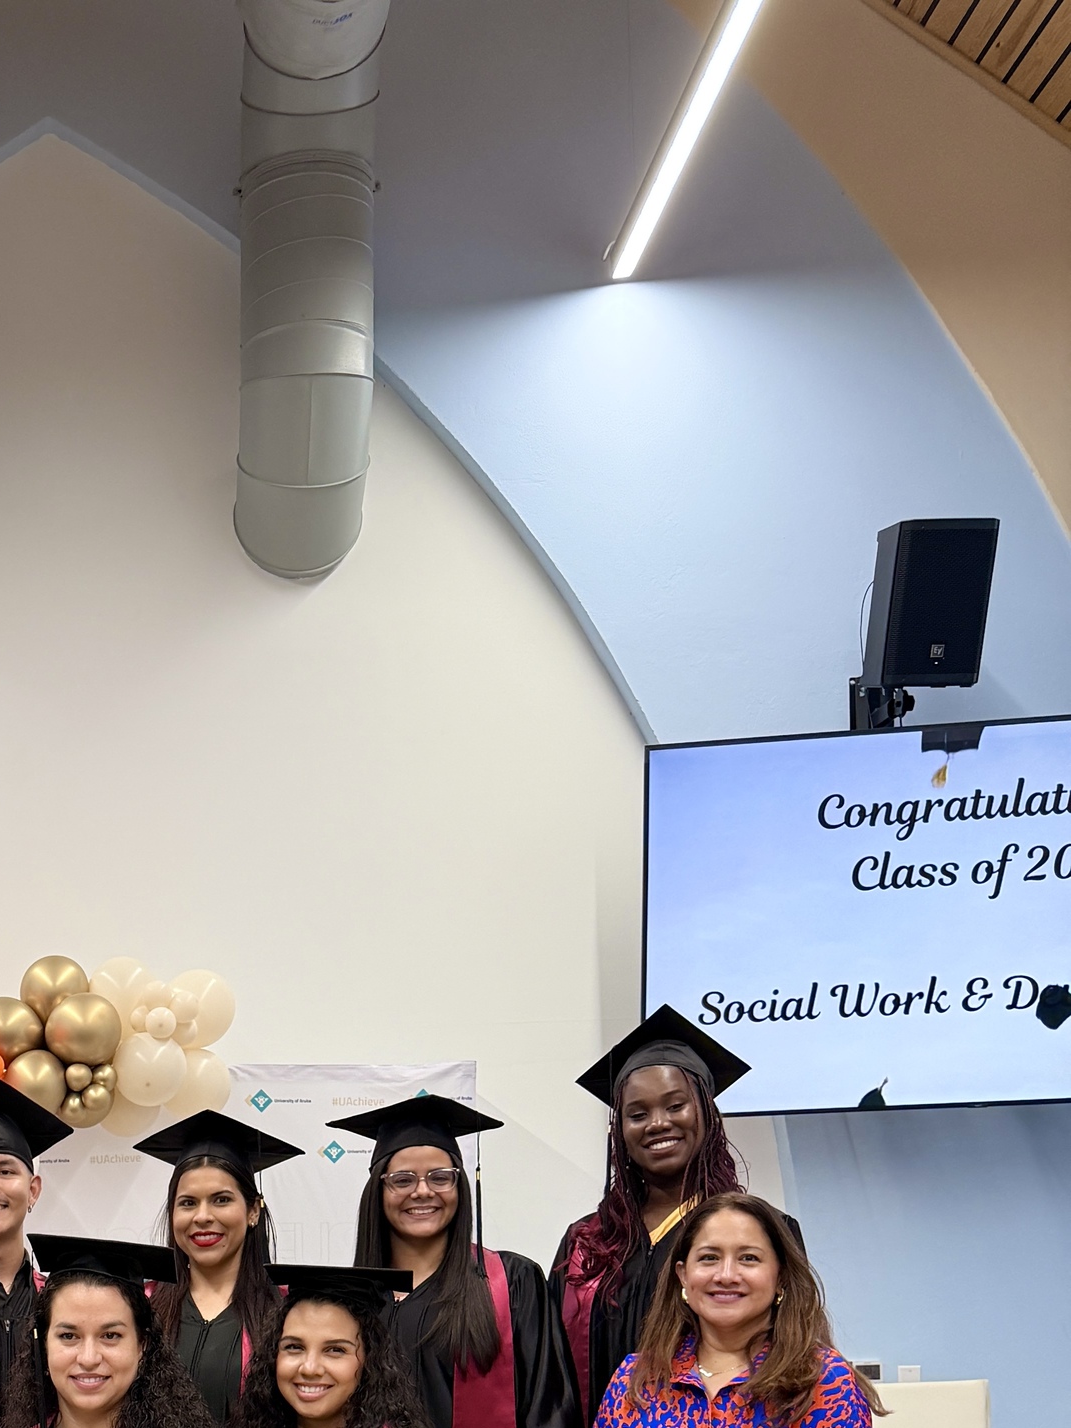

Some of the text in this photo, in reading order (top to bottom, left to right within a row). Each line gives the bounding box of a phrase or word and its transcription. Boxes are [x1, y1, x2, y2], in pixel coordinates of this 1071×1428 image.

[851, 850, 959, 892] Class
[972, 843, 1020, 900] of
[698, 982, 821, 1026] Social
[830, 976, 951, 1018] Work
[962, 978, 993, 1012] &
[332, 1097, 385, 1107] #UAchieve
[90, 1154, 142, 1165] #UAchieve
